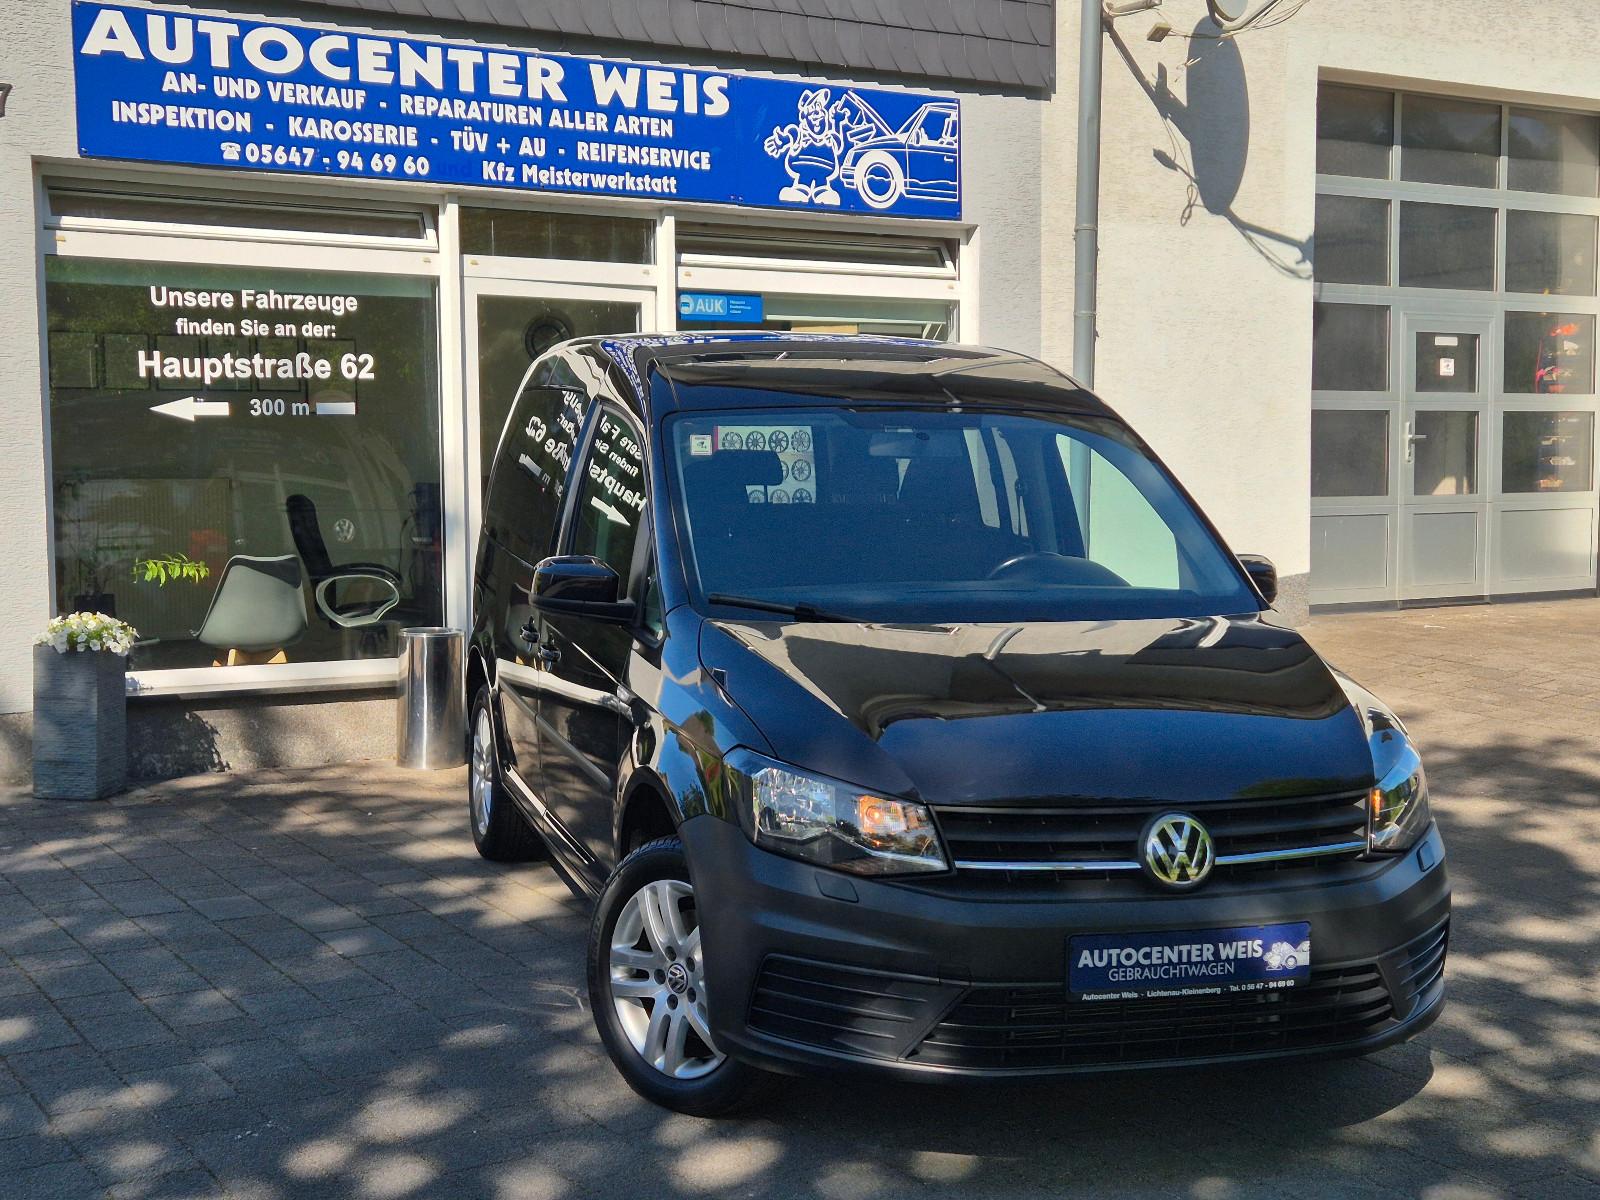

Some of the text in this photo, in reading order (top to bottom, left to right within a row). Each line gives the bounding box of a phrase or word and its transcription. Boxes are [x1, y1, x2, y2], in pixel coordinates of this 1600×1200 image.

[80, 8, 732, 118] AUTOCENTER WEIS
[162, 71, 207, 96] AN-
[213, 76, 262, 101] UND
[266, 80, 367, 111] VERKAUF
[399, 93, 543, 128] REPARATUREN
[548, 107, 609, 133] ALLER
[613, 114, 674, 139] ARTEN
[111, 100, 252, 133] INSPEKTION
[287, 115, 420, 148] KAROSSERIE
[450, 126, 489, 152] TÜV
[518, 136, 547, 158] AU
[576, 141, 712, 170] REIFENSERVICE
[244, 145, 316, 168] 05647
[336, 149, 364, 171] 94
[370, 152, 397, 174] 69
[402, 155, 431, 176] 60
[482, 160, 515, 183] Kfz
[521, 164, 678, 194] Meisterwerkstatt
[150, 285, 359, 316] Unsere Fahrzeuge
[175, 317, 337, 338] finden Sie an der:
[137, 350, 375, 385] Hauptstraße 62
[250, 398, 310, 417] 300 m
[1077, 939, 1264, 969] AUTOCENTER WEIS
[1108, 961, 1235, 982] GEBRAUCHTWAGEN
[1082, 992, 1120, 1001] Autocenter
[1121, 991, 1138, 999] Weis
